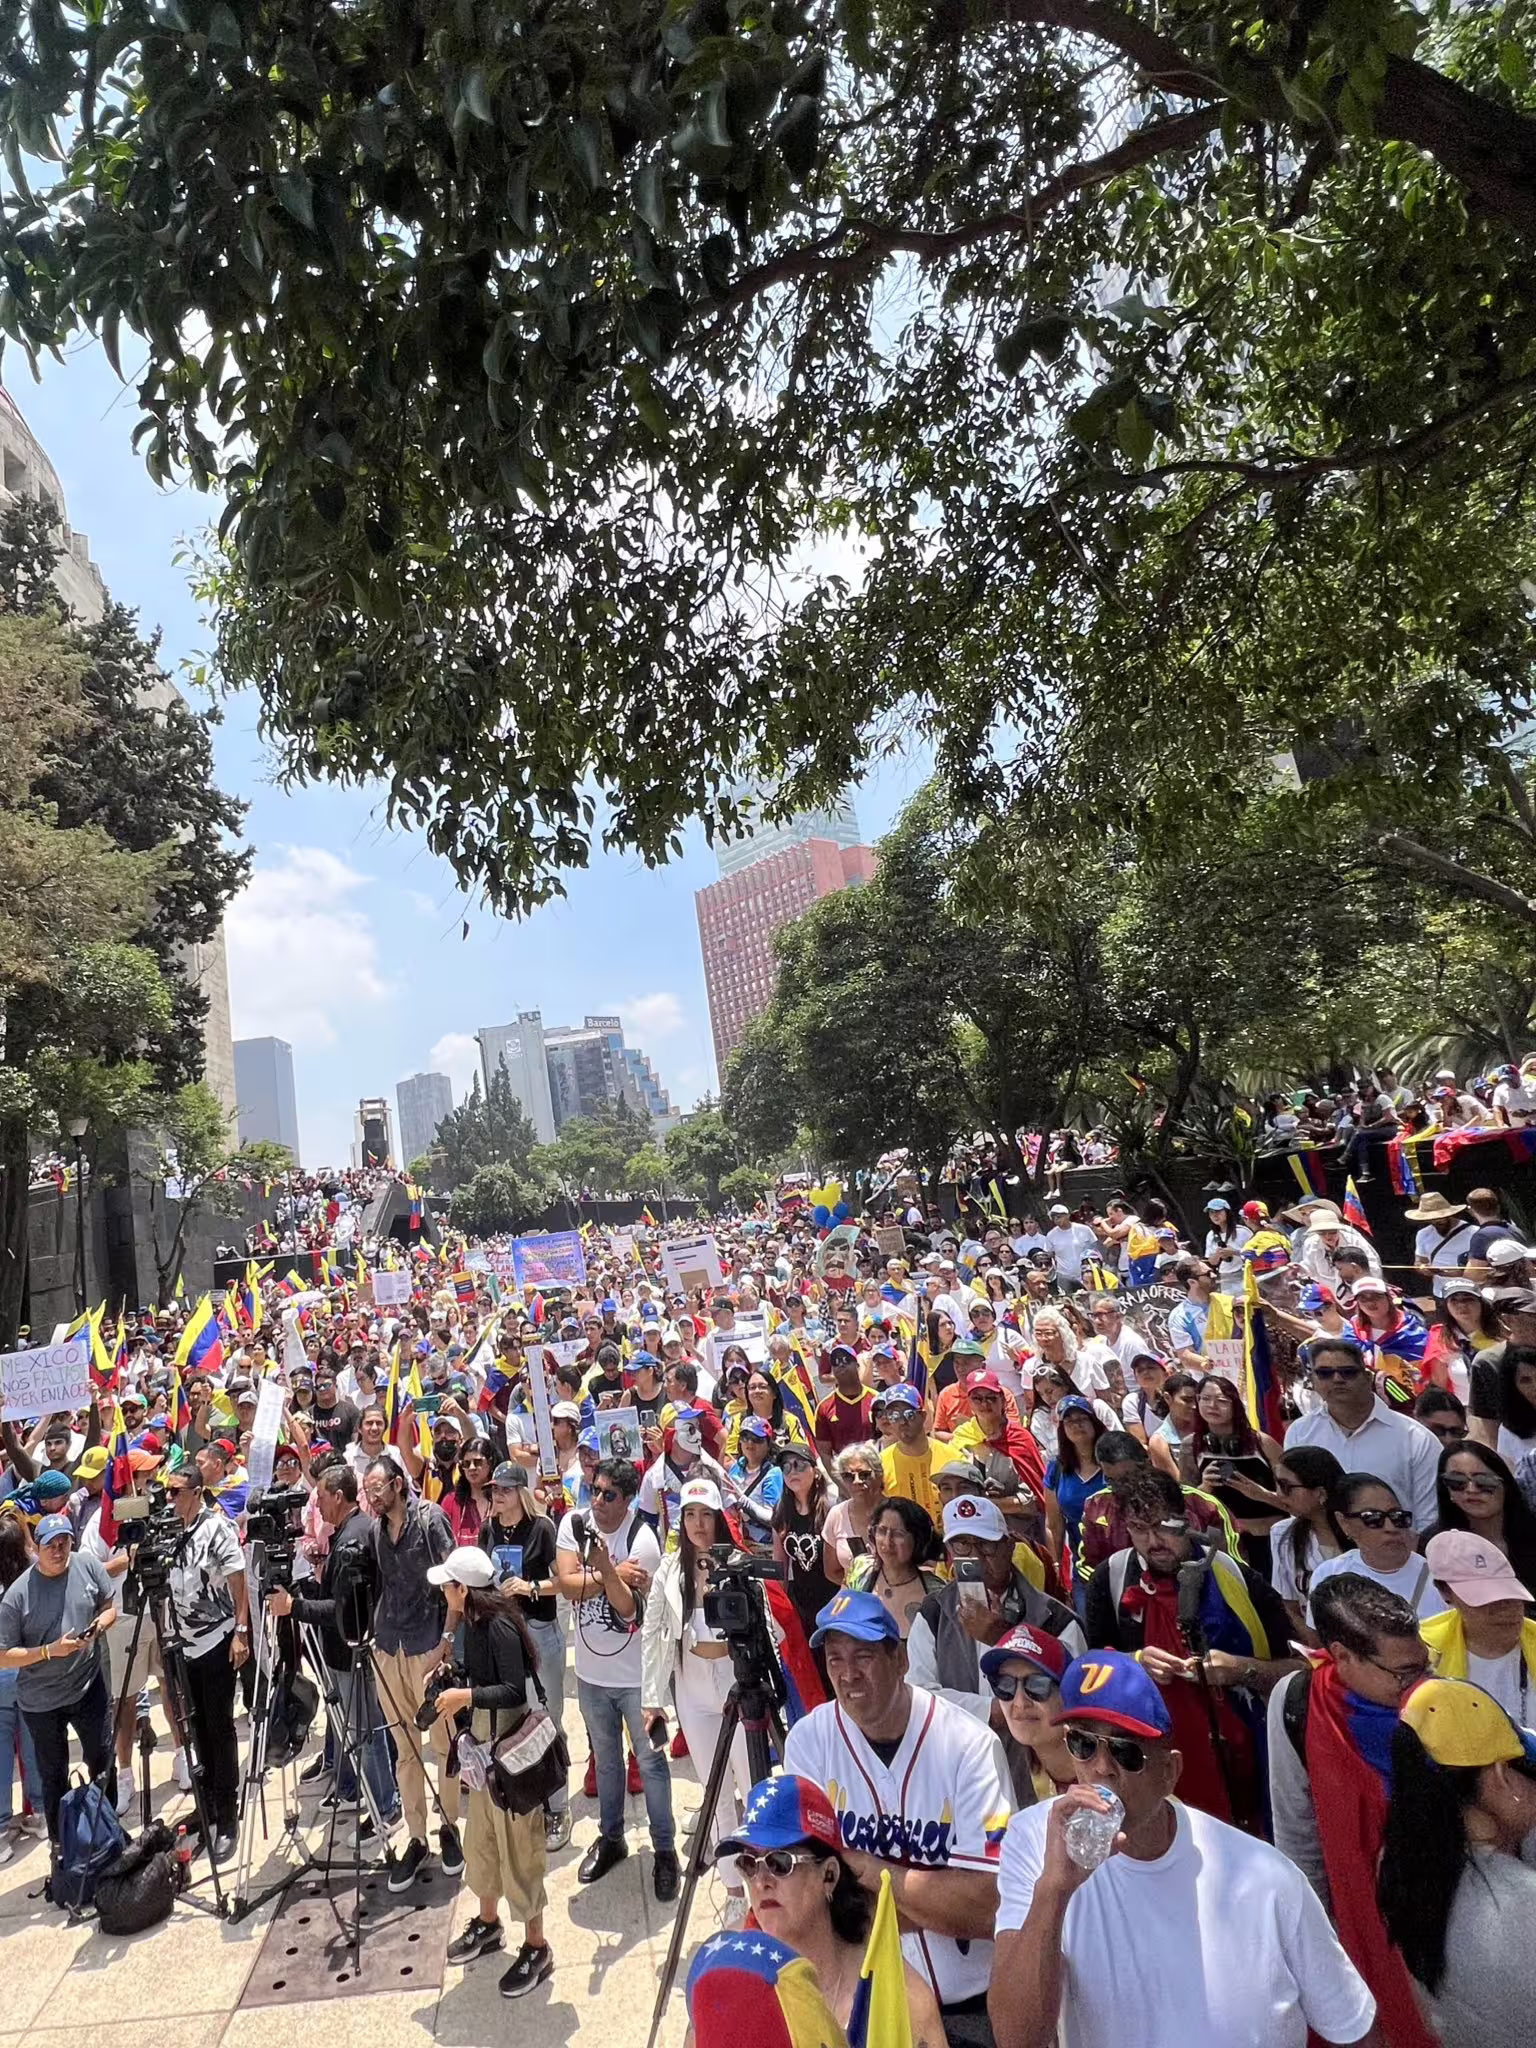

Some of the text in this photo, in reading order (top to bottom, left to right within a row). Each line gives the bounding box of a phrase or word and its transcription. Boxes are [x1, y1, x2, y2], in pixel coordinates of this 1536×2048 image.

[1, 1348, 79, 1377] MEXICO
[3, 1378, 30, 1393] NOS
[5, 1391, 38, 1408] AYER
[315, 1417, 341, 1428] HUGO
